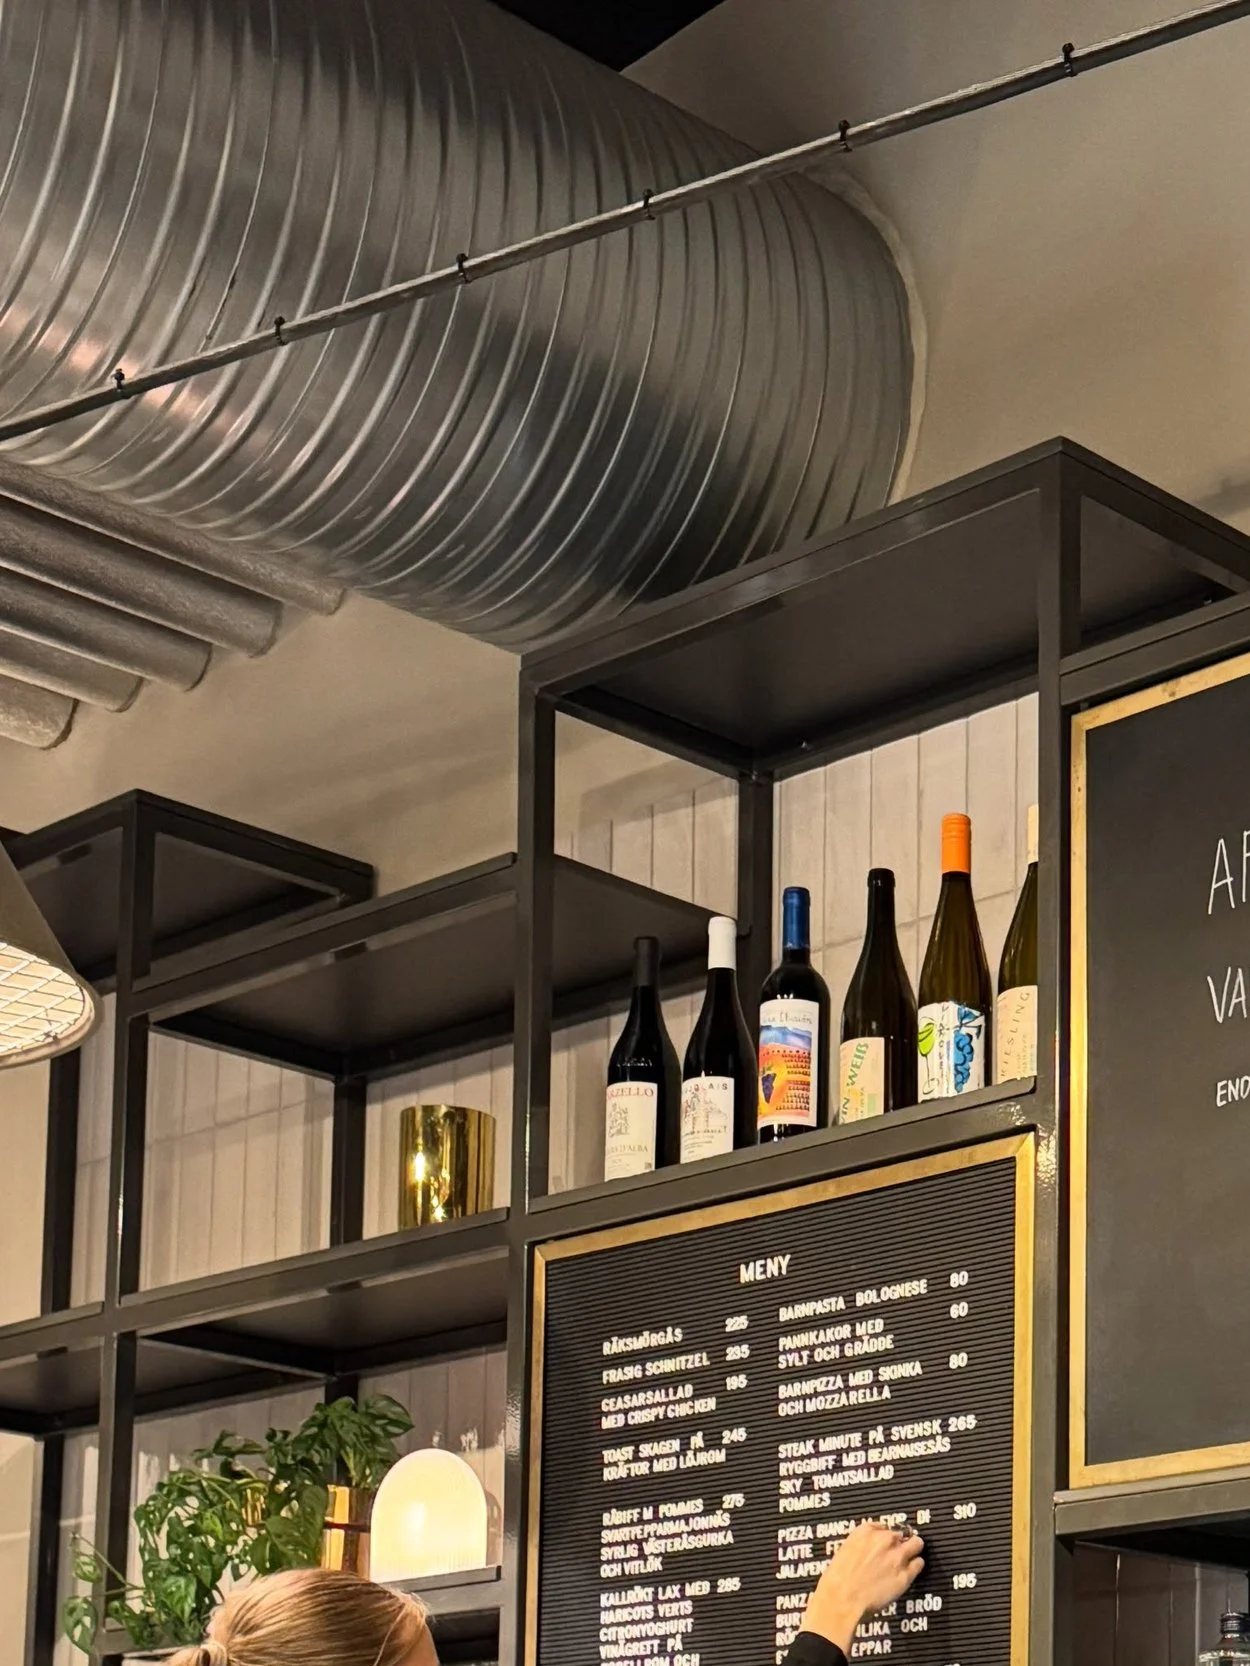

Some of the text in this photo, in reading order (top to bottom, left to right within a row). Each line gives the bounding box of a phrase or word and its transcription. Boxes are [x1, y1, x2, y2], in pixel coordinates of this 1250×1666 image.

[740, 1254, 790, 1284] MENY
[779, 1271, 968, 1321] BARNPASTA BOLOGNESE 80
[603, 1316, 749, 1355] RÄKSMÖRGÅS 225
[779, 1302, 968, 1350] PANNKAKOR 60
[778, 1335, 894, 1369] SYLT GRÄDDE
[603, 1365, 642, 1384] FRASIG
[646, 1352, 710, 1376] SCHNITZEL
[779, 1352, 968, 1399] BARNPIZZA SKINKA 80
[602, 1374, 747, 1411] CEASARSALLAD 195
[779, 1385, 891, 1416] OCH MOZZARELLA
[628, 1397, 716, 1425] CRISPY CHICKEN
[602, 1428, 747, 1463] TOAST SKAGEN 245
[779, 1415, 977, 1458] STEAK MINUTE SVENSK 265
[680, 1448, 726, 1468] LÖJROM
[779, 1455, 836, 1476] RYGGBIFF
[779, 1465, 894, 1494] SKY TOMATSALLAD
[659, 1498, 703, 1518] POMMES
[779, 1492, 831, 1513] POMMES
[778, 1525, 813, 1543] PIZZA
[601, 1544, 638, 1561] SYRLIG
[778, 1544, 813, 1561] LATTE
[624, 1556, 662, 1575] VITLÖK
[953, 1573, 977, 1589] 195
[601, 1585, 680, 1607] KALLRÖKT LAX
[906, 1594, 942, 1613] BRÖD
[601, 1600, 692, 1624] HARICOTS VERTS
[600, 1618, 694, 1642] CITRONYOGHURT
[901, 1617, 928, 1632] OCH
